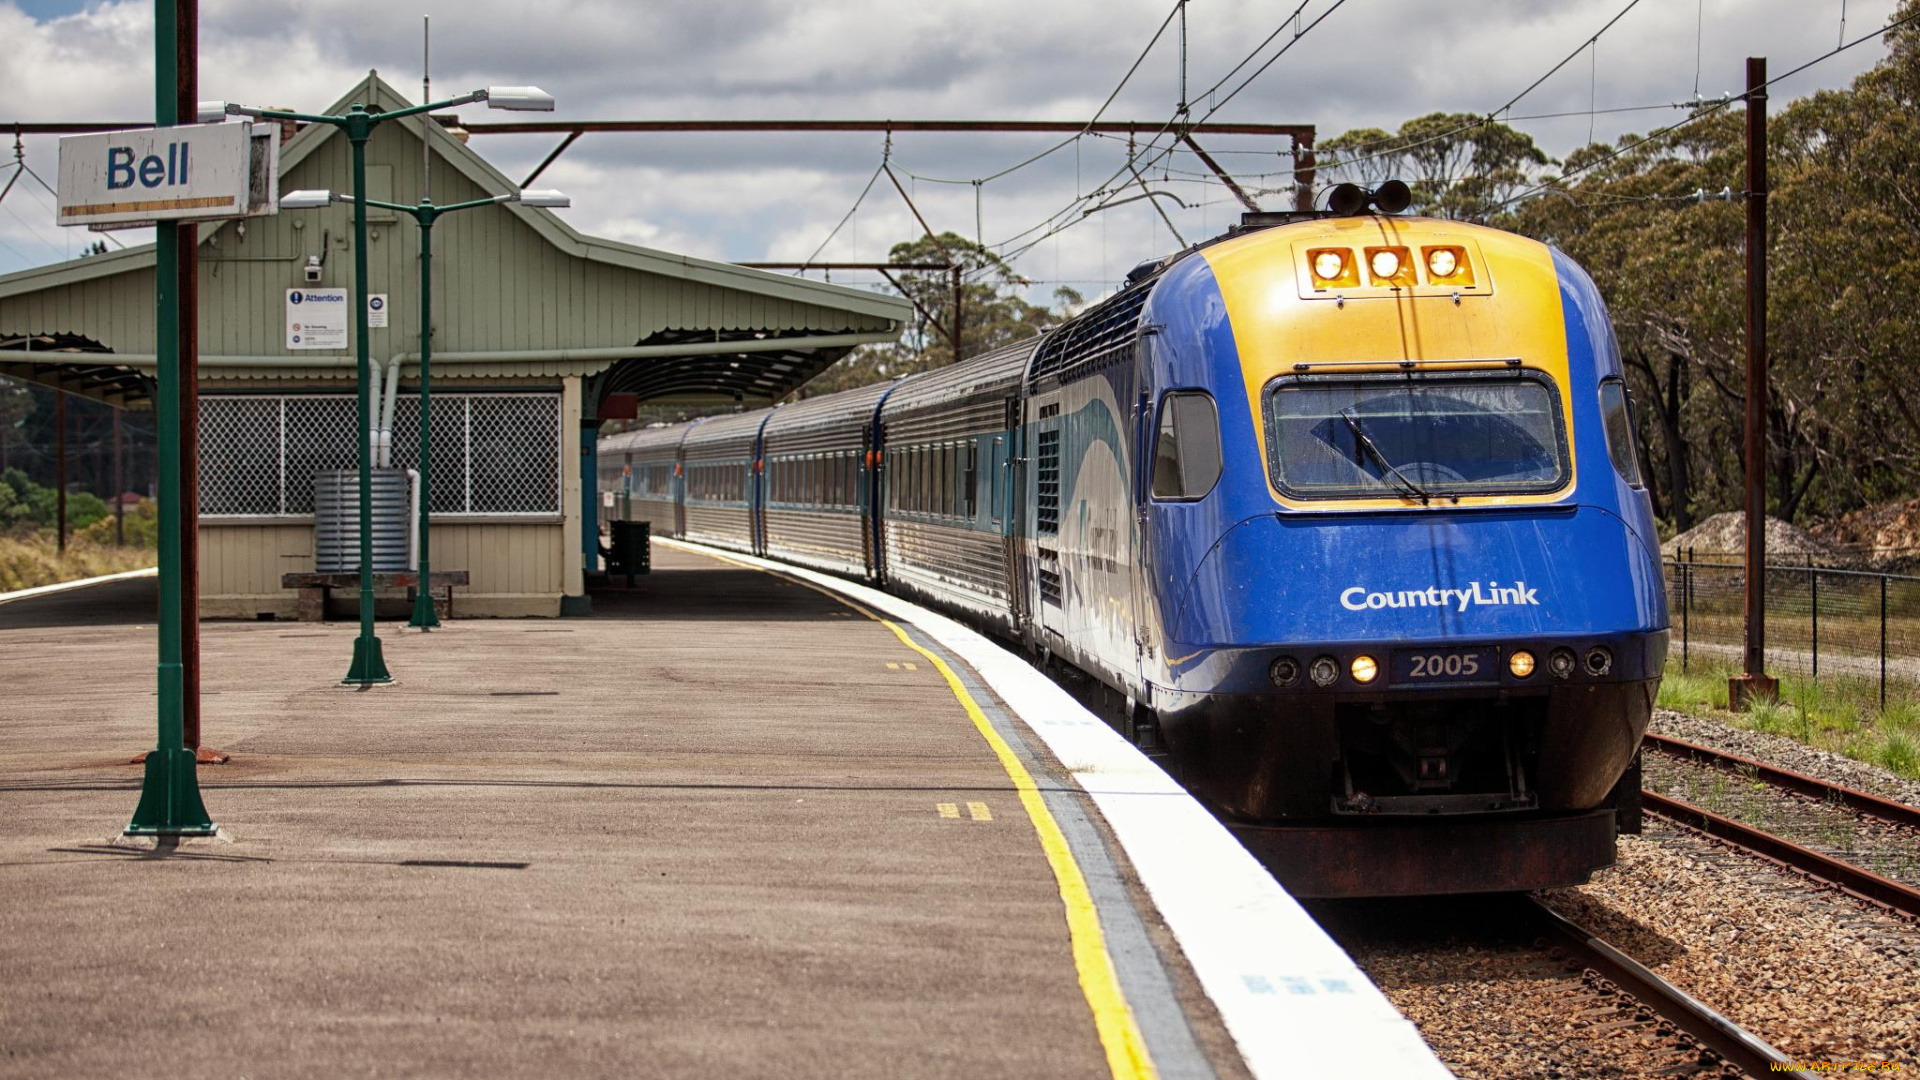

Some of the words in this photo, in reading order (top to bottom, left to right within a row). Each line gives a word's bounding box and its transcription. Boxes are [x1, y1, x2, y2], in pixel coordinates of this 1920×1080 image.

[107, 142, 189, 189] Bell
[305, 294, 343, 303] Attention
[1340, 581, 1539, 611] CountryLink
[1409, 655, 1478, 677] 2005
